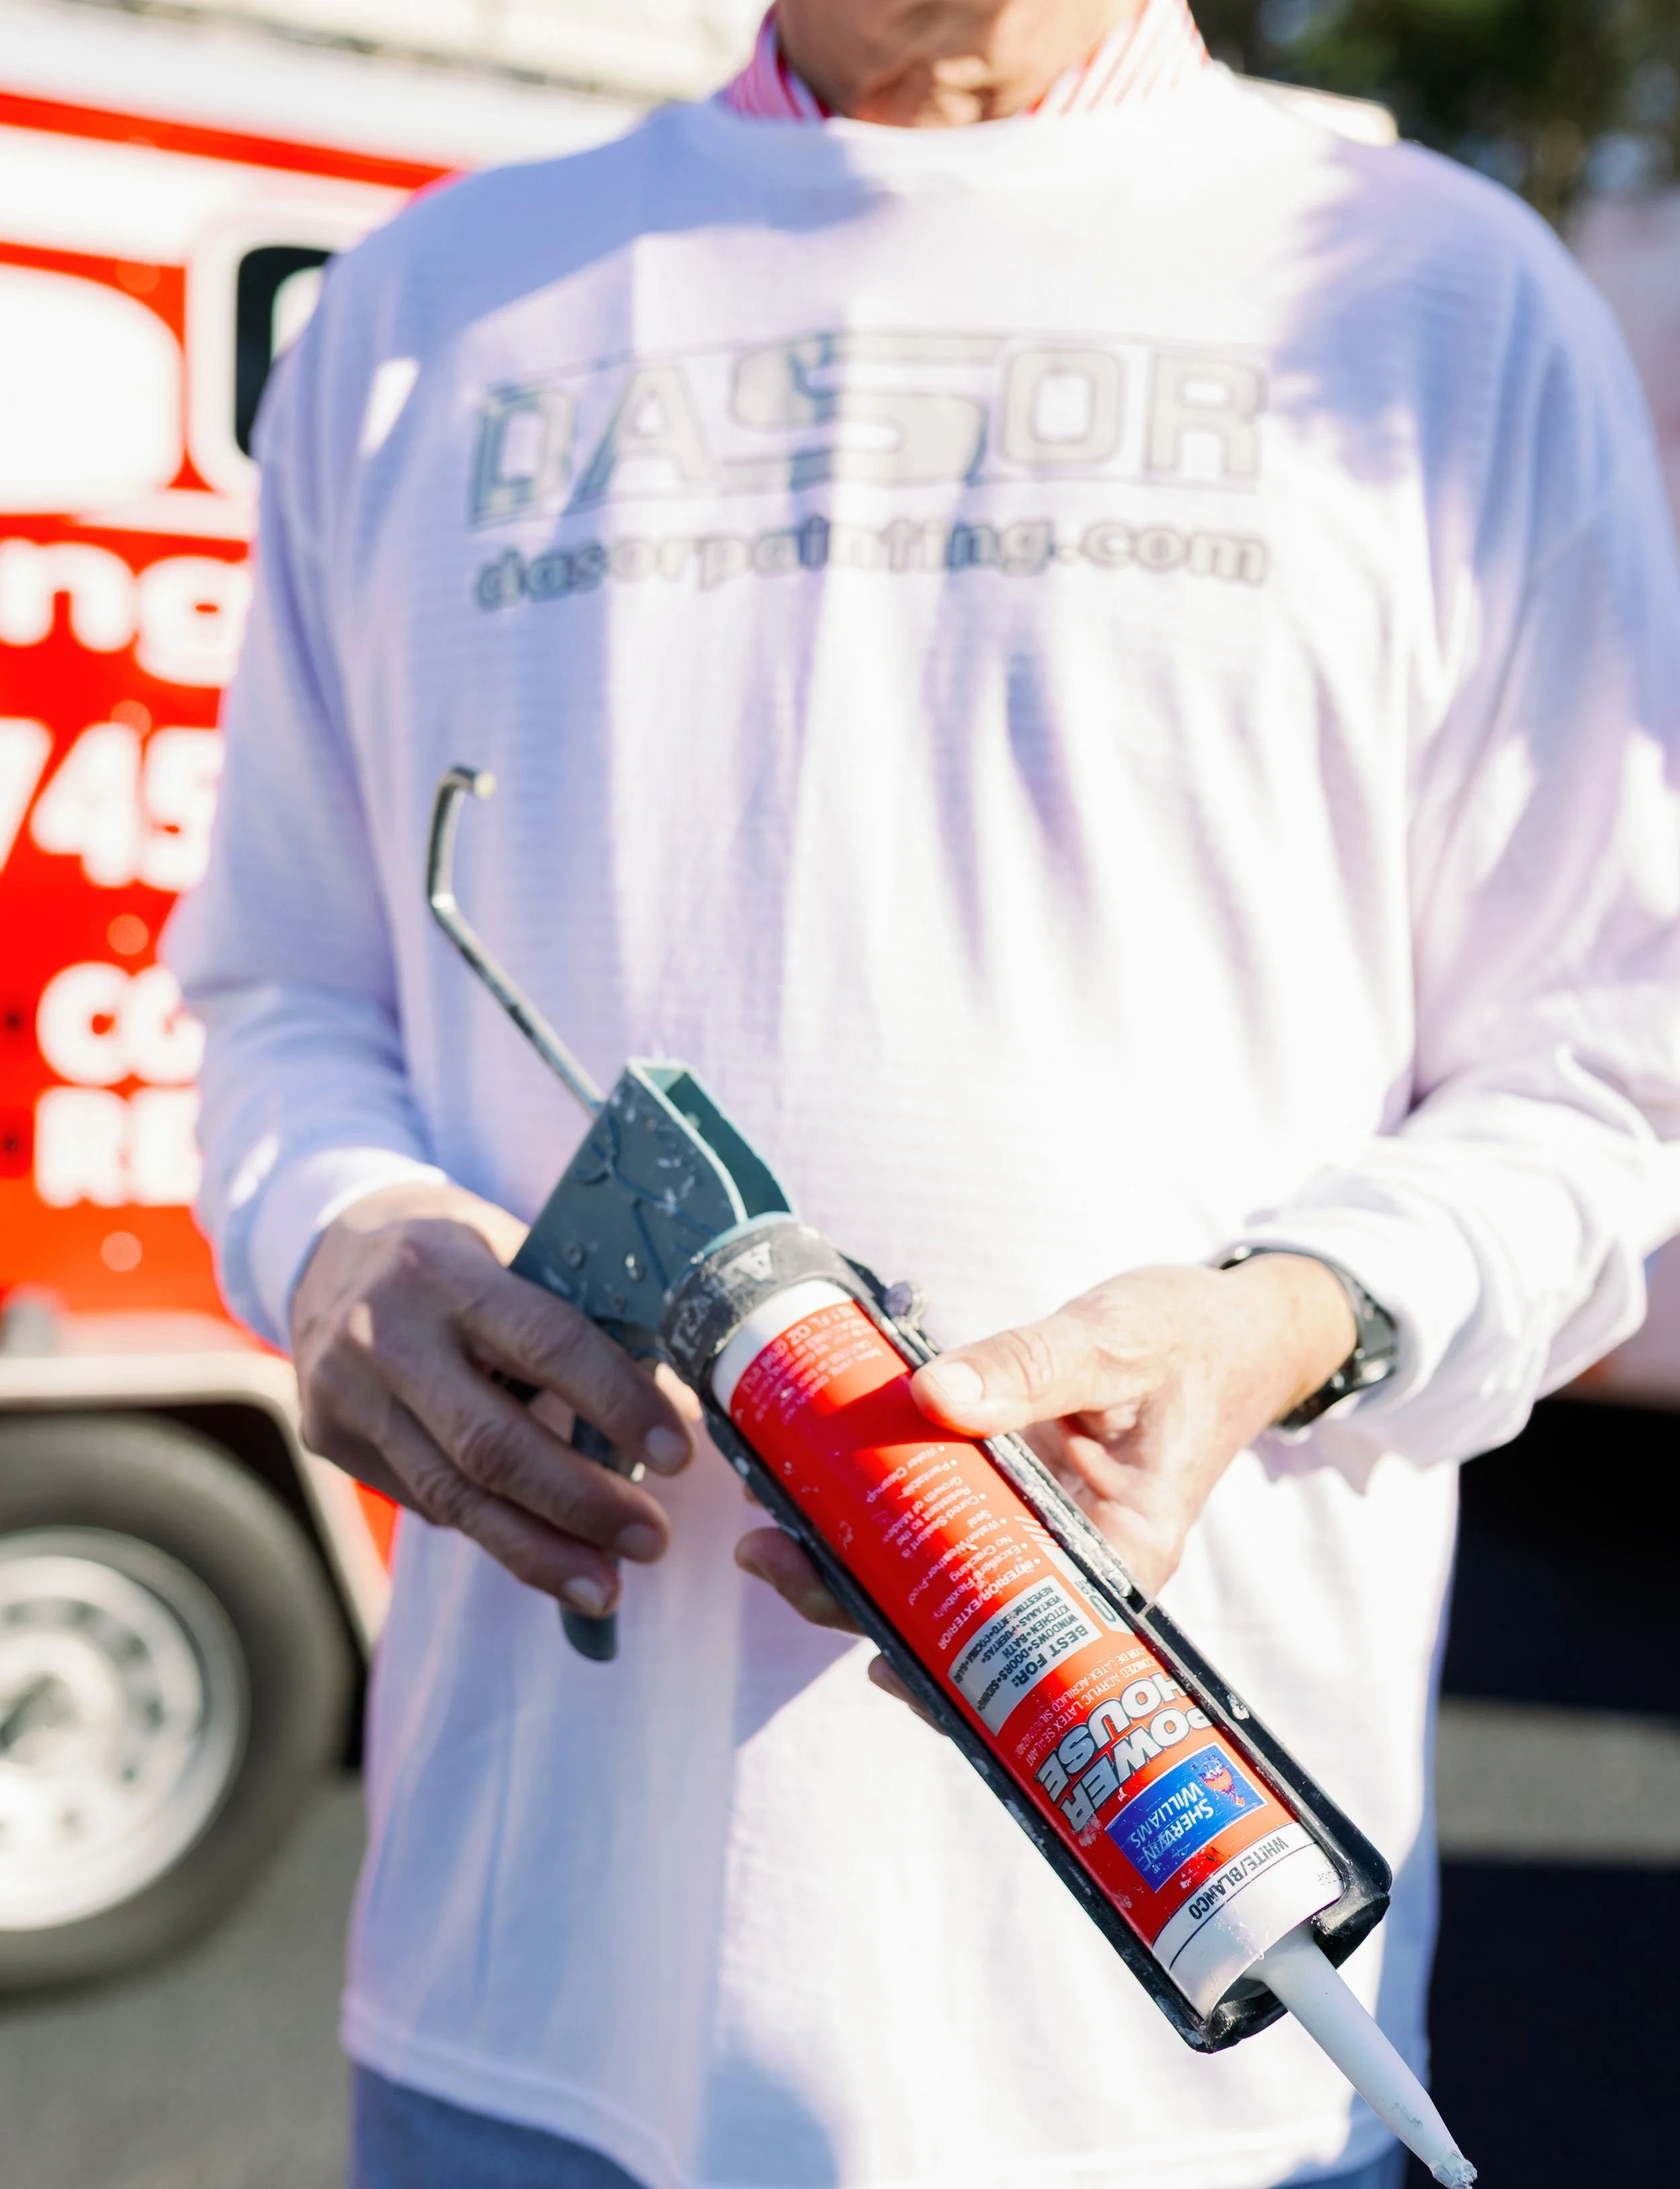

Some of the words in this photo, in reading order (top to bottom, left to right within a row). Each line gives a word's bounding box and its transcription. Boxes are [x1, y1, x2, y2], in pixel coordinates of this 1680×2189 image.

[468, 331, 1267, 532] DASOR
[474, 514, 1270, 610] dasorpainting.com
[783, 1321, 813, 1347] OZ
[807, 1313, 831, 1326] FL
[865, 1464, 909, 1504] Cleanup
[922, 1475, 963, 1503] Growth
[911, 1499, 925, 1515] of
[966, 1508, 992, 1528] Seal
[895, 1529, 913, 1546] the
[910, 1518, 924, 1531] to
[994, 1534, 1013, 1547] No
[947, 1542, 997, 1582] Cracking
[937, 1559, 1035, 1650] INTERIOR/EXTERIOR
[1048, 1624, 1088, 1657] BEST
[1010, 1653, 1048, 1688] FOR:
[1115, 1653, 1129, 1664] DE
[1081, 1672, 1120, 1706] ACRYLIC
[1052, 1700, 1083, 1731] LATEX
[1025, 1727, 1056, 1766] SEALANT
[1033, 1667, 1187, 1803] HOUSE
[1058, 1704, 1212, 1833] POWER
[1128, 1781, 1204, 1848] WILLIAMS
[1140, 1797, 1214, 1864] SHERWIN
[1187, 1836, 1288, 1920] WHITE/BLANCO
